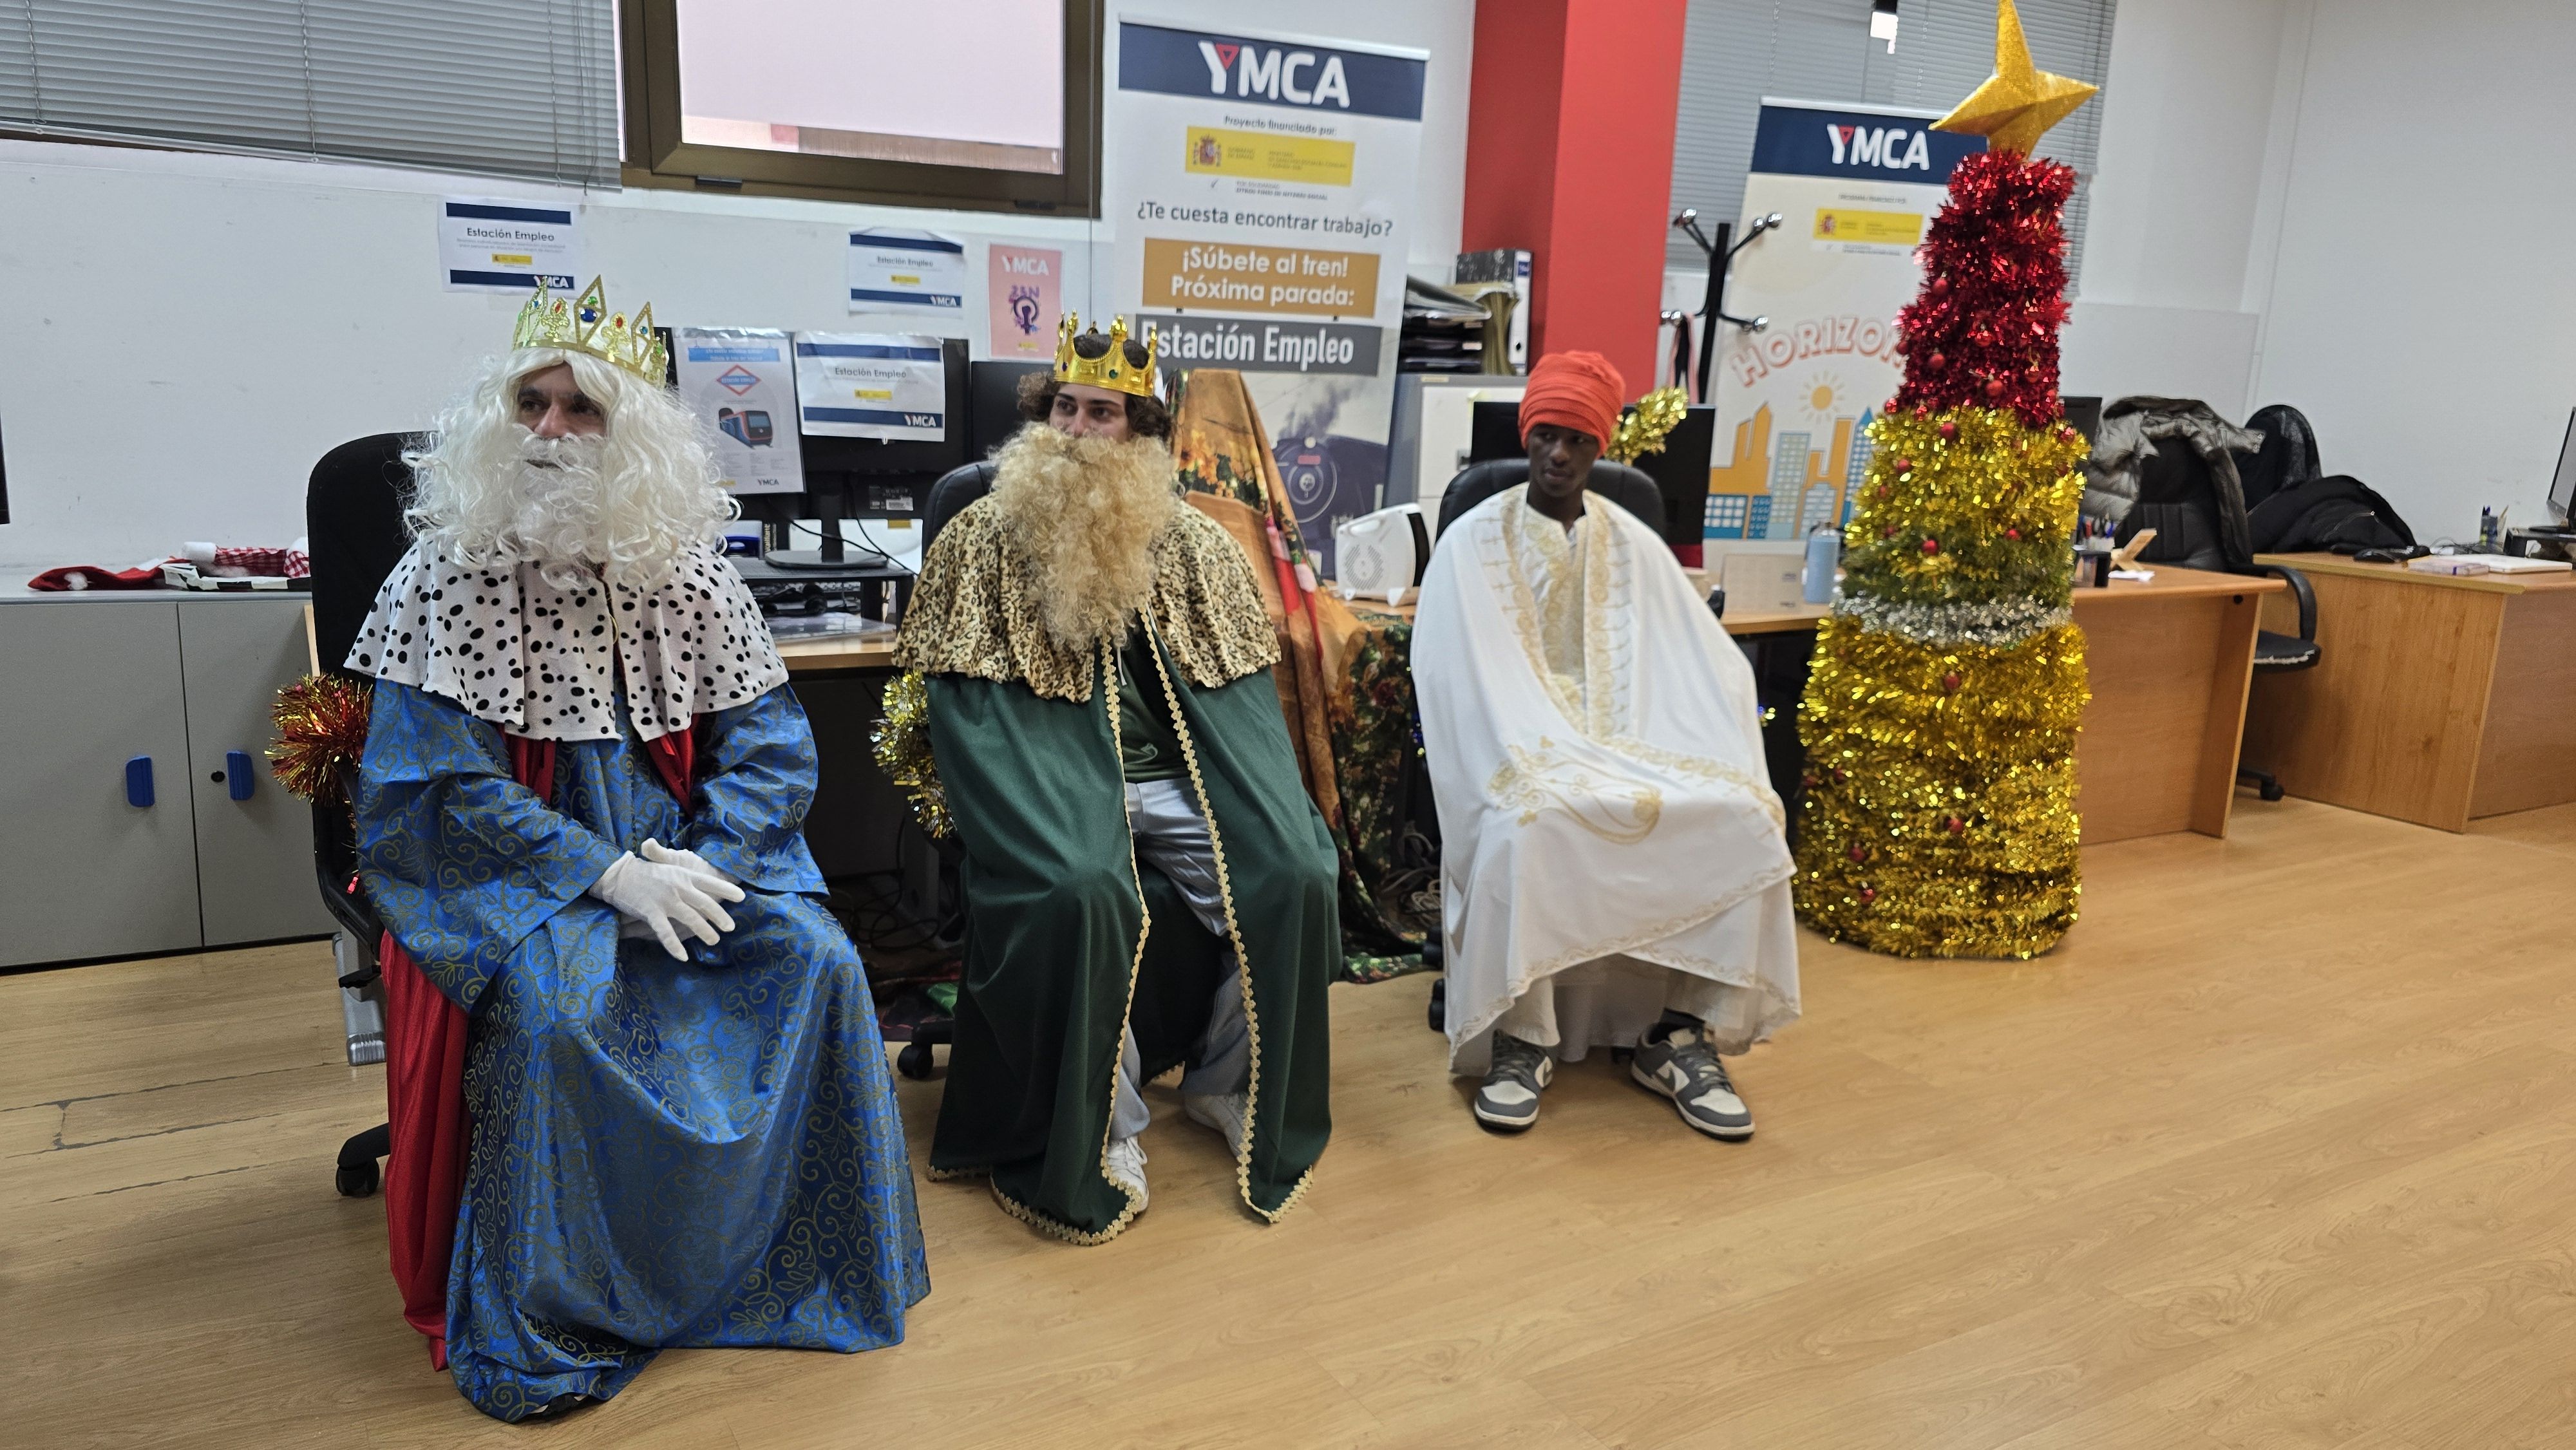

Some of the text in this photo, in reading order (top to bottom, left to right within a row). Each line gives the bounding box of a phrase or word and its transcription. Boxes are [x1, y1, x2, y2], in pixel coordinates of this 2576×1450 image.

[1198, 40, 1350, 108] YMCA
[1225, 115, 1266, 128] Proyecto
[1826, 123, 1930, 171] YMCA
[467, 227, 555, 241] Estación Empleo
[1137, 202, 1393, 239] ¿Te cuesta encontrar trabajo?
[1001, 254, 1050, 276] YMCA
[1182, 245, 1349, 278] ¡Súbete al tren!
[930, 294, 957, 306] YMCA
[1171, 274, 1354, 308] Próxima parada:
[1263, 325, 1354, 372] Empleo
[835, 366, 907, 379] Estación Empleo
[904, 413, 936, 428] YMCA
